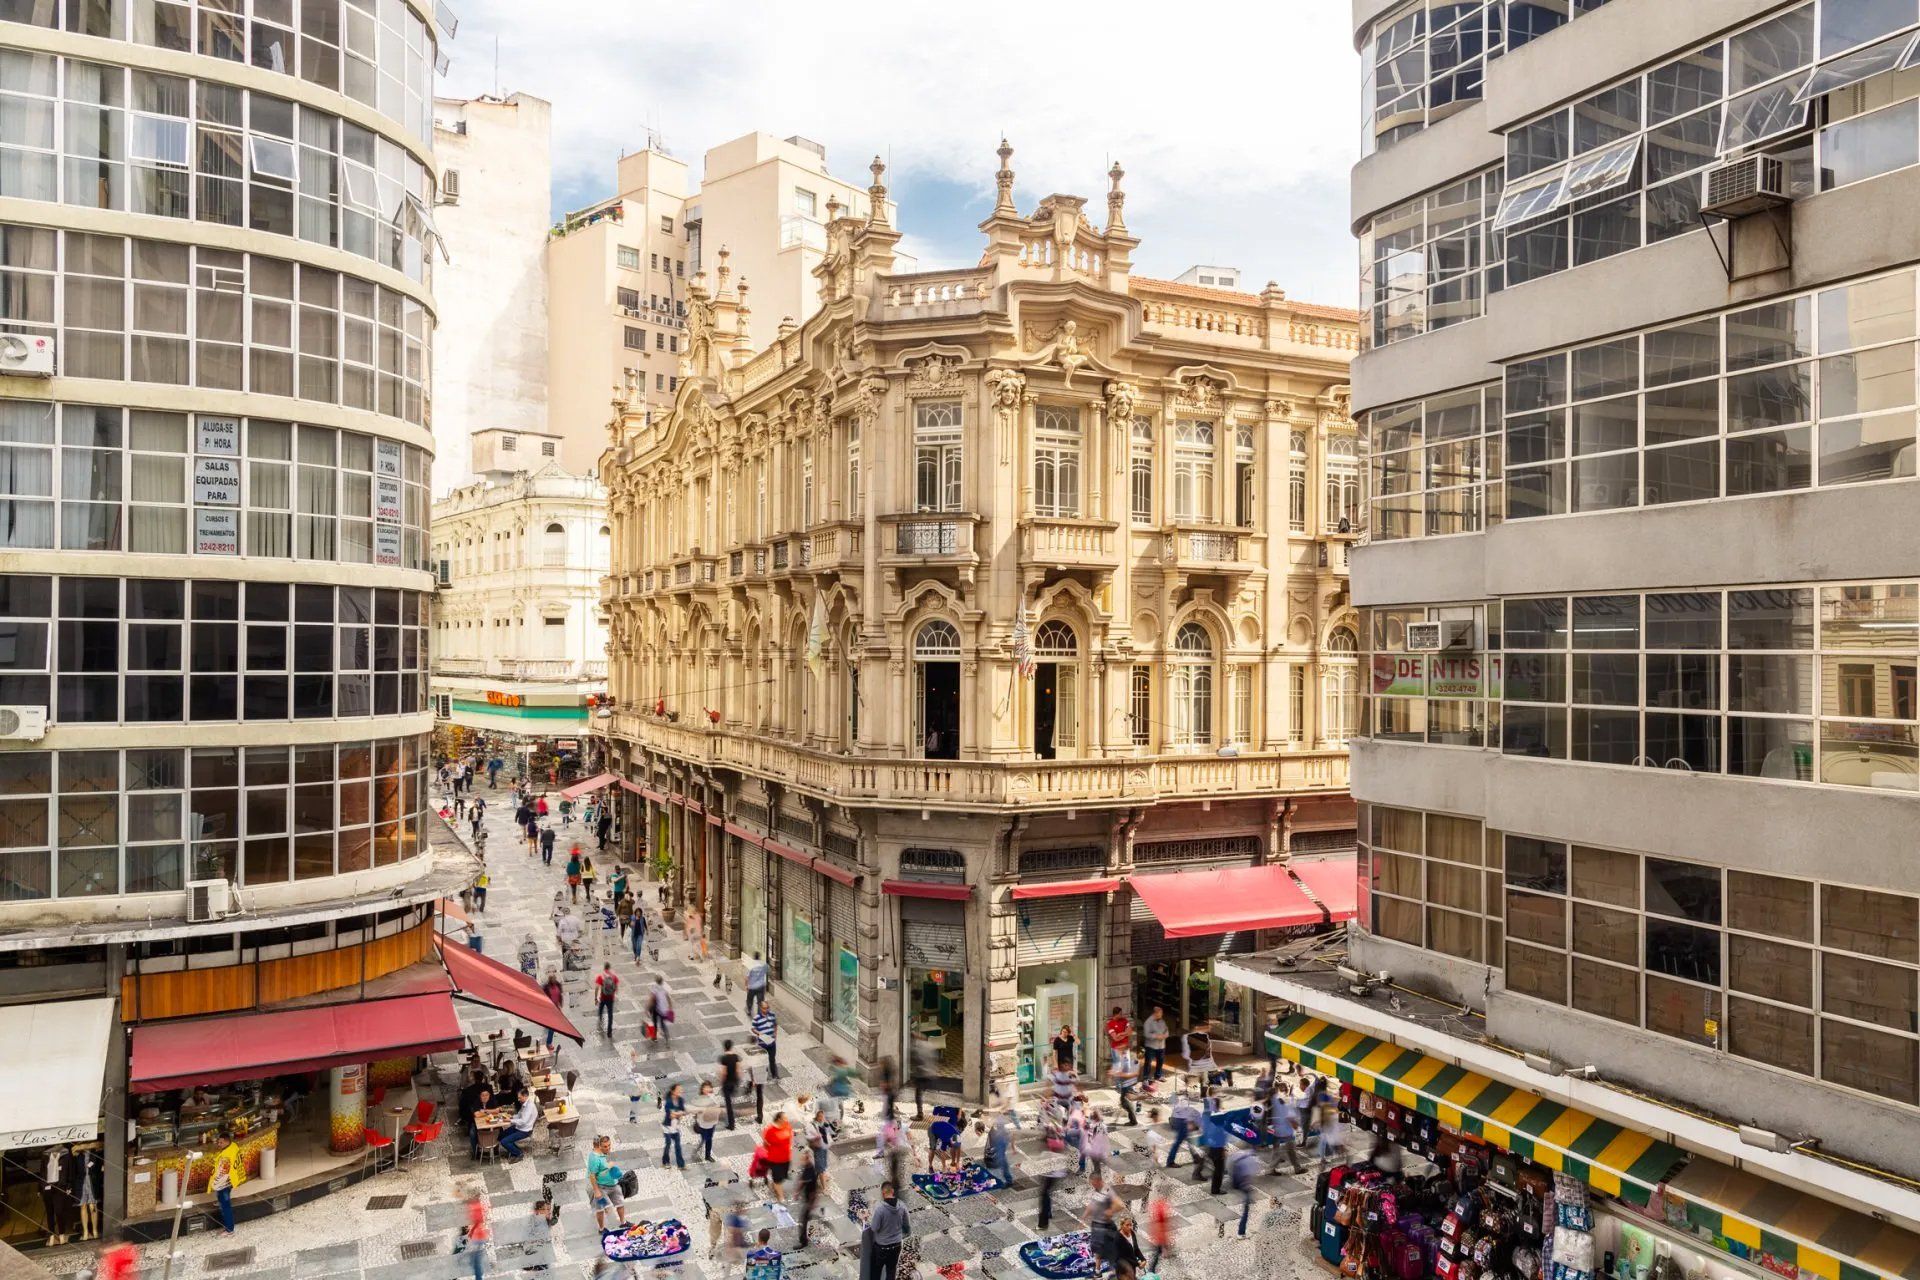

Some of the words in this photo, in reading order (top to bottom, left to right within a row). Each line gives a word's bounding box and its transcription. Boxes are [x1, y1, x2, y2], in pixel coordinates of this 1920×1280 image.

[202, 421, 234, 433] ALUGA-SE
[213, 438, 232, 449] HORA
[204, 461, 230, 471] SALAS
[195, 475, 239, 486] EQUIPADAS
[207, 491, 227, 500] PARA
[205, 515, 224, 523] CURSOS
[199, 542, 235, 552] 3242-8210
